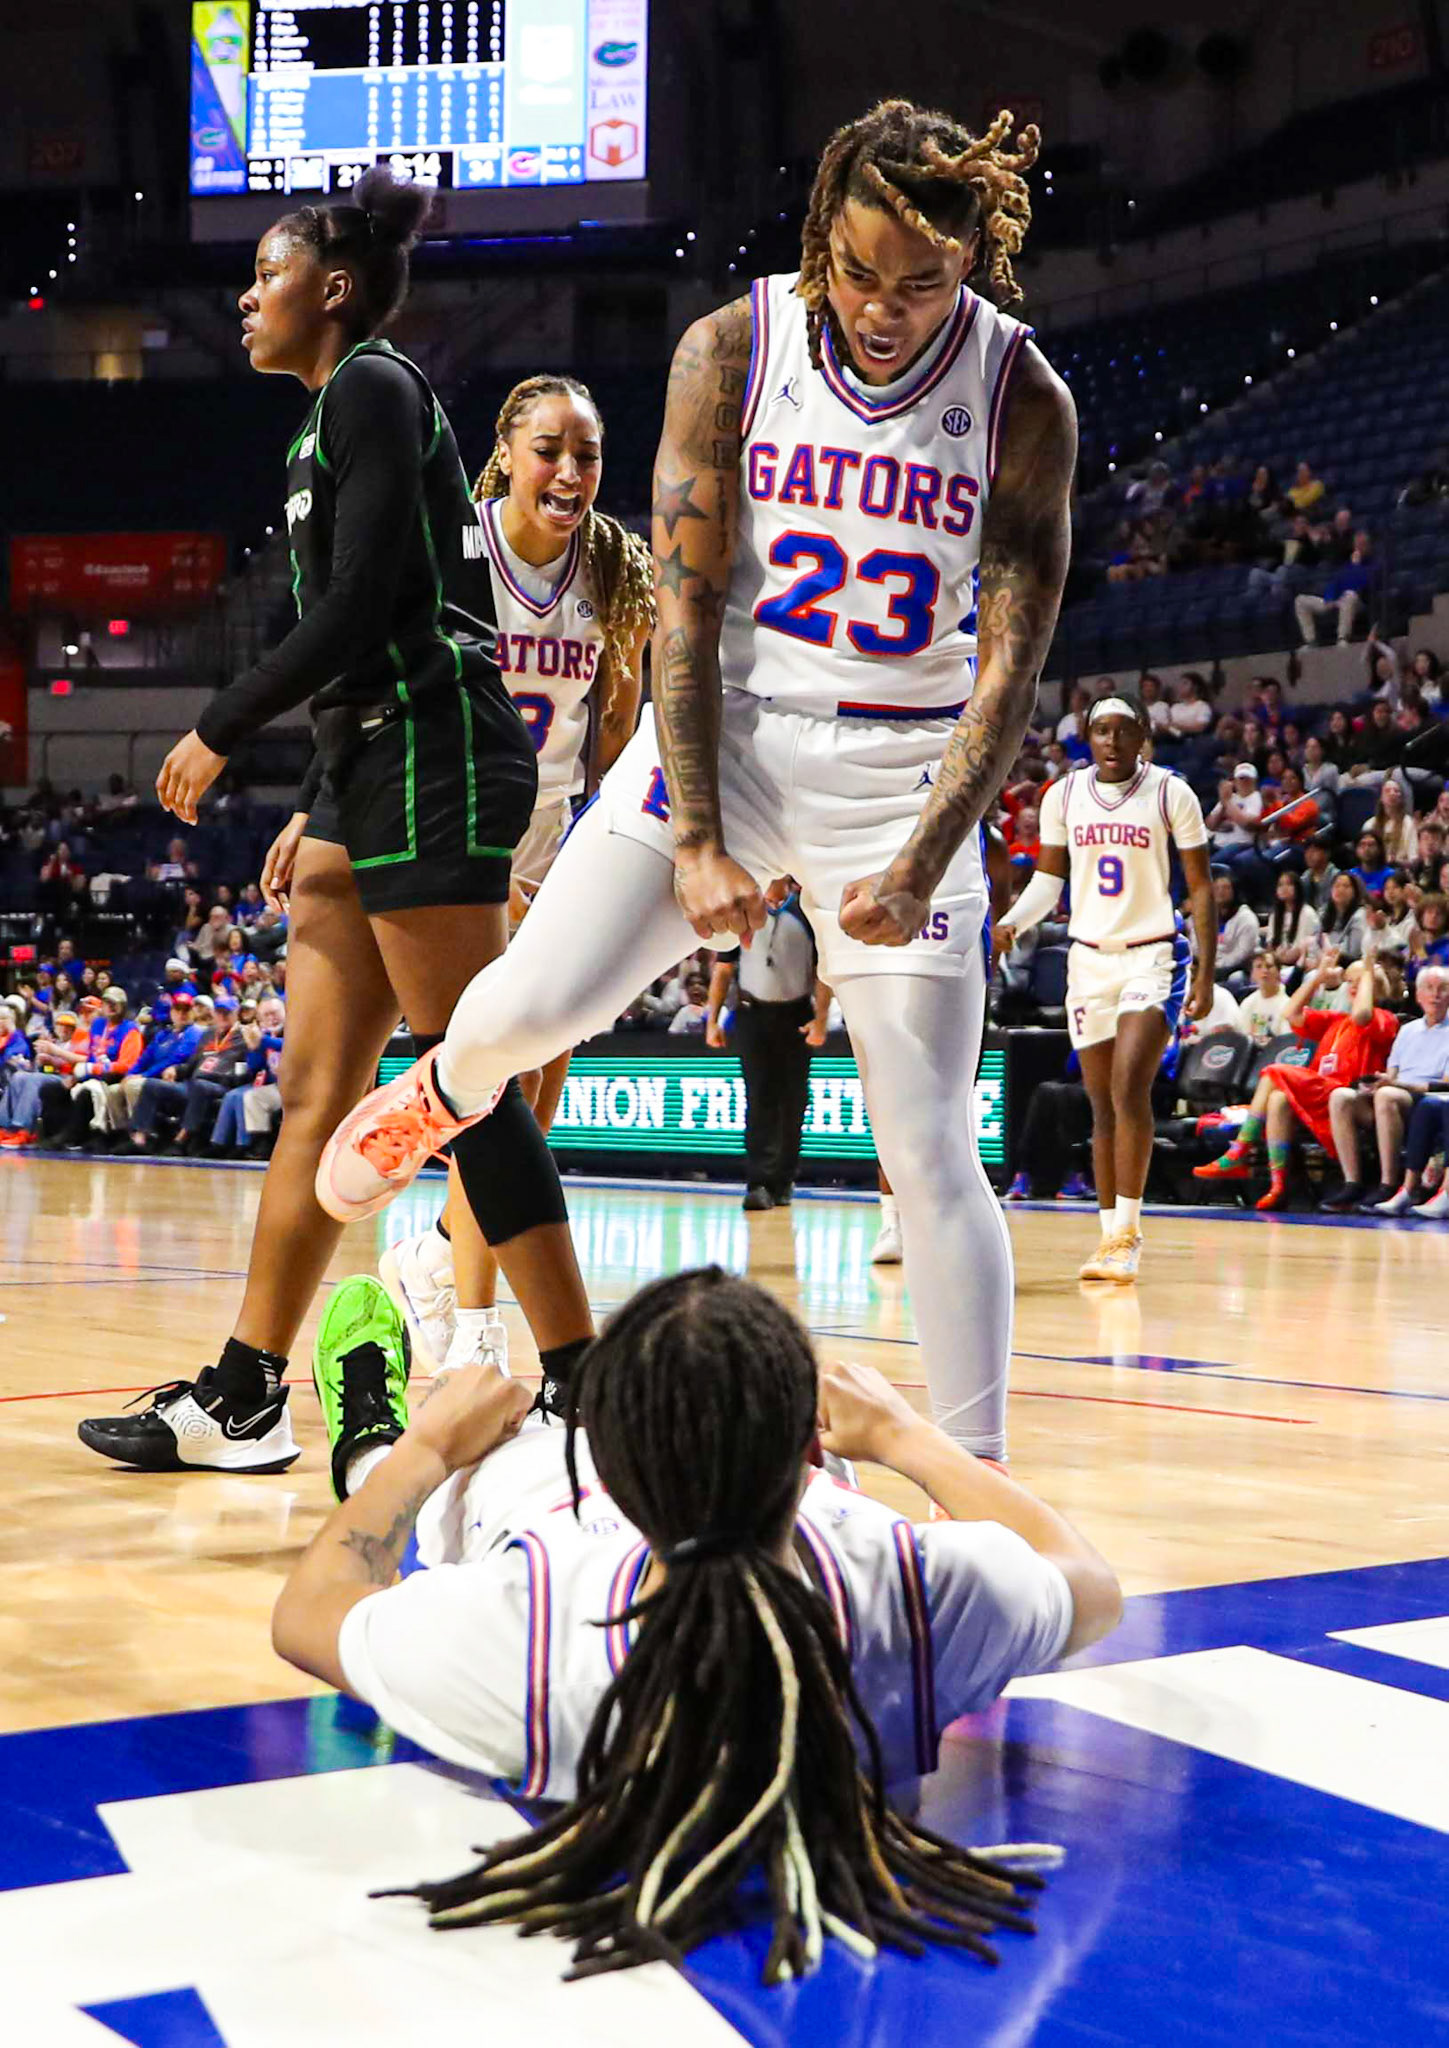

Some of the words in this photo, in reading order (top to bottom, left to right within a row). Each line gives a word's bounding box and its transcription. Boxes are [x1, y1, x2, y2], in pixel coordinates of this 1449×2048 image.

[942, 408, 970, 436] SEC
[748, 441, 980, 537] GATORS
[754, 528, 941, 657] 23
[492, 632, 597, 682] ATORS
[1073, 822, 1151, 849] GATORS
[1097, 854, 1125, 898] 9
[1074, 1006, 1087, 1036] F
[551, 1076, 665, 1128] NION
